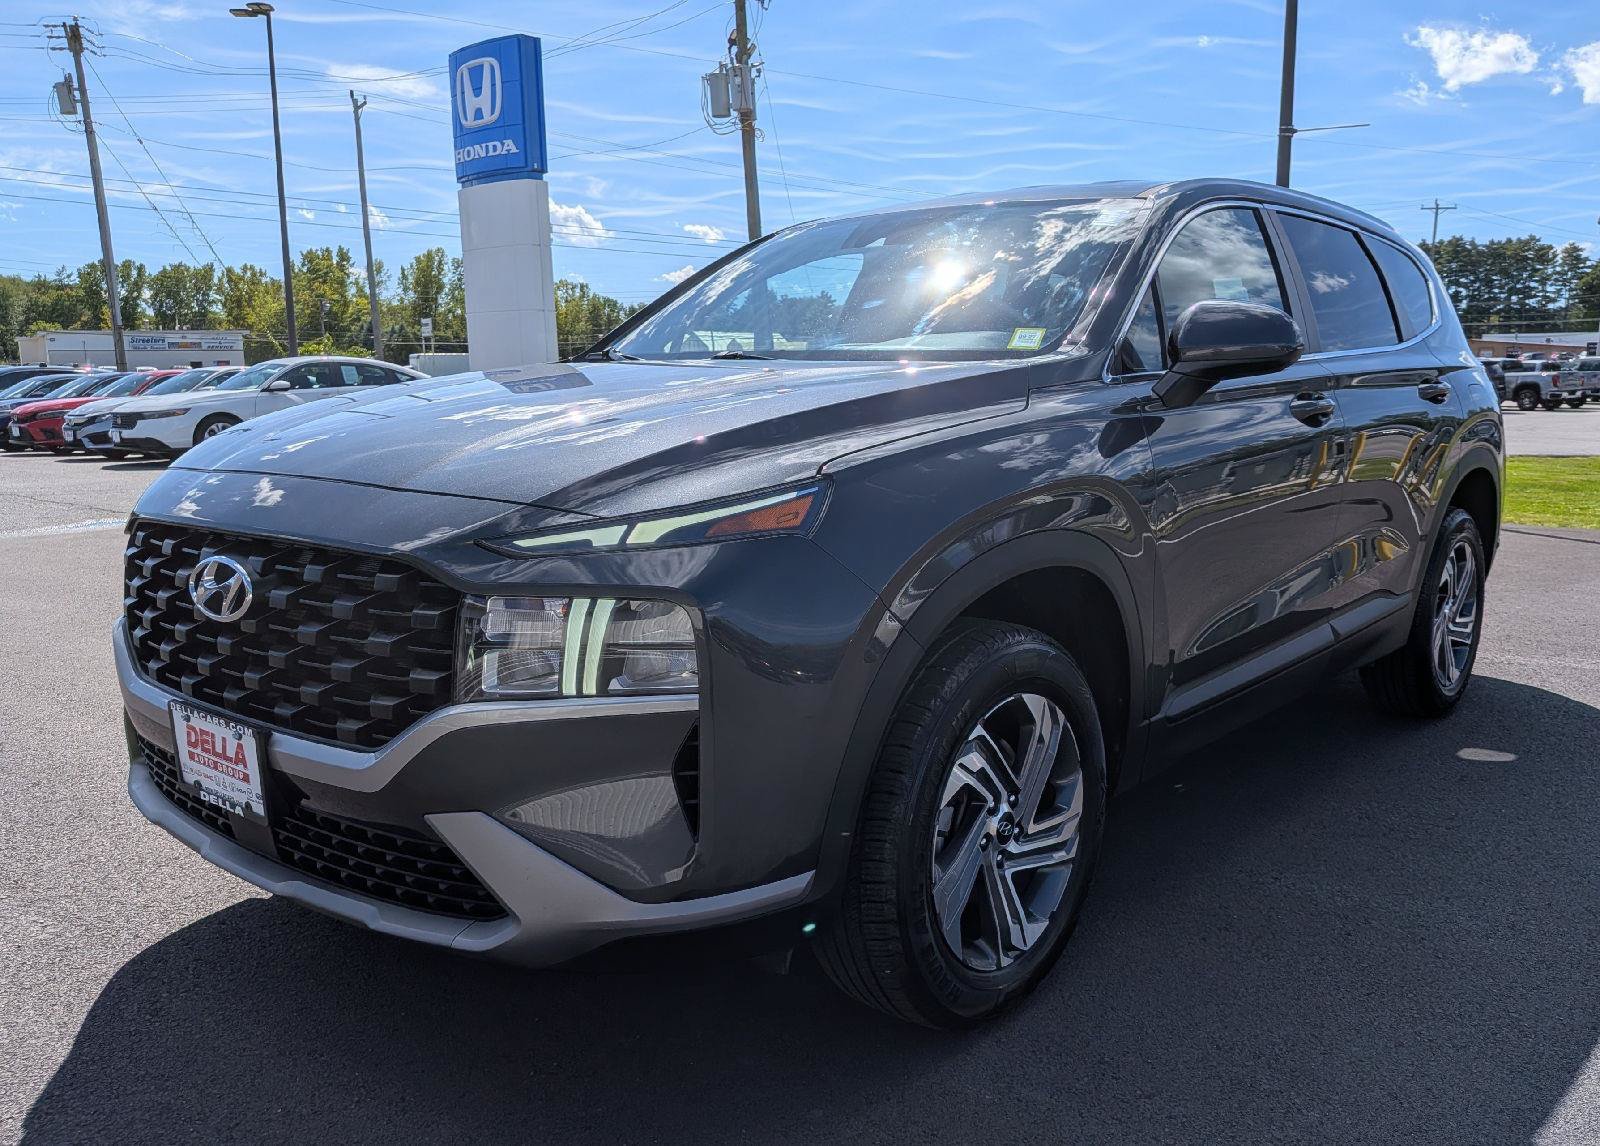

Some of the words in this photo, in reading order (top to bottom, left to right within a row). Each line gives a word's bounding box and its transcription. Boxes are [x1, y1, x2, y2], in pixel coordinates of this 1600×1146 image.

[455, 139, 520, 164] HONDA
[170, 701, 253, 737] DELLACARS.COM
[186, 723, 249, 770] DELLA
[194, 754, 215, 768] AUTO
[217, 763, 244, 780] GROUP
